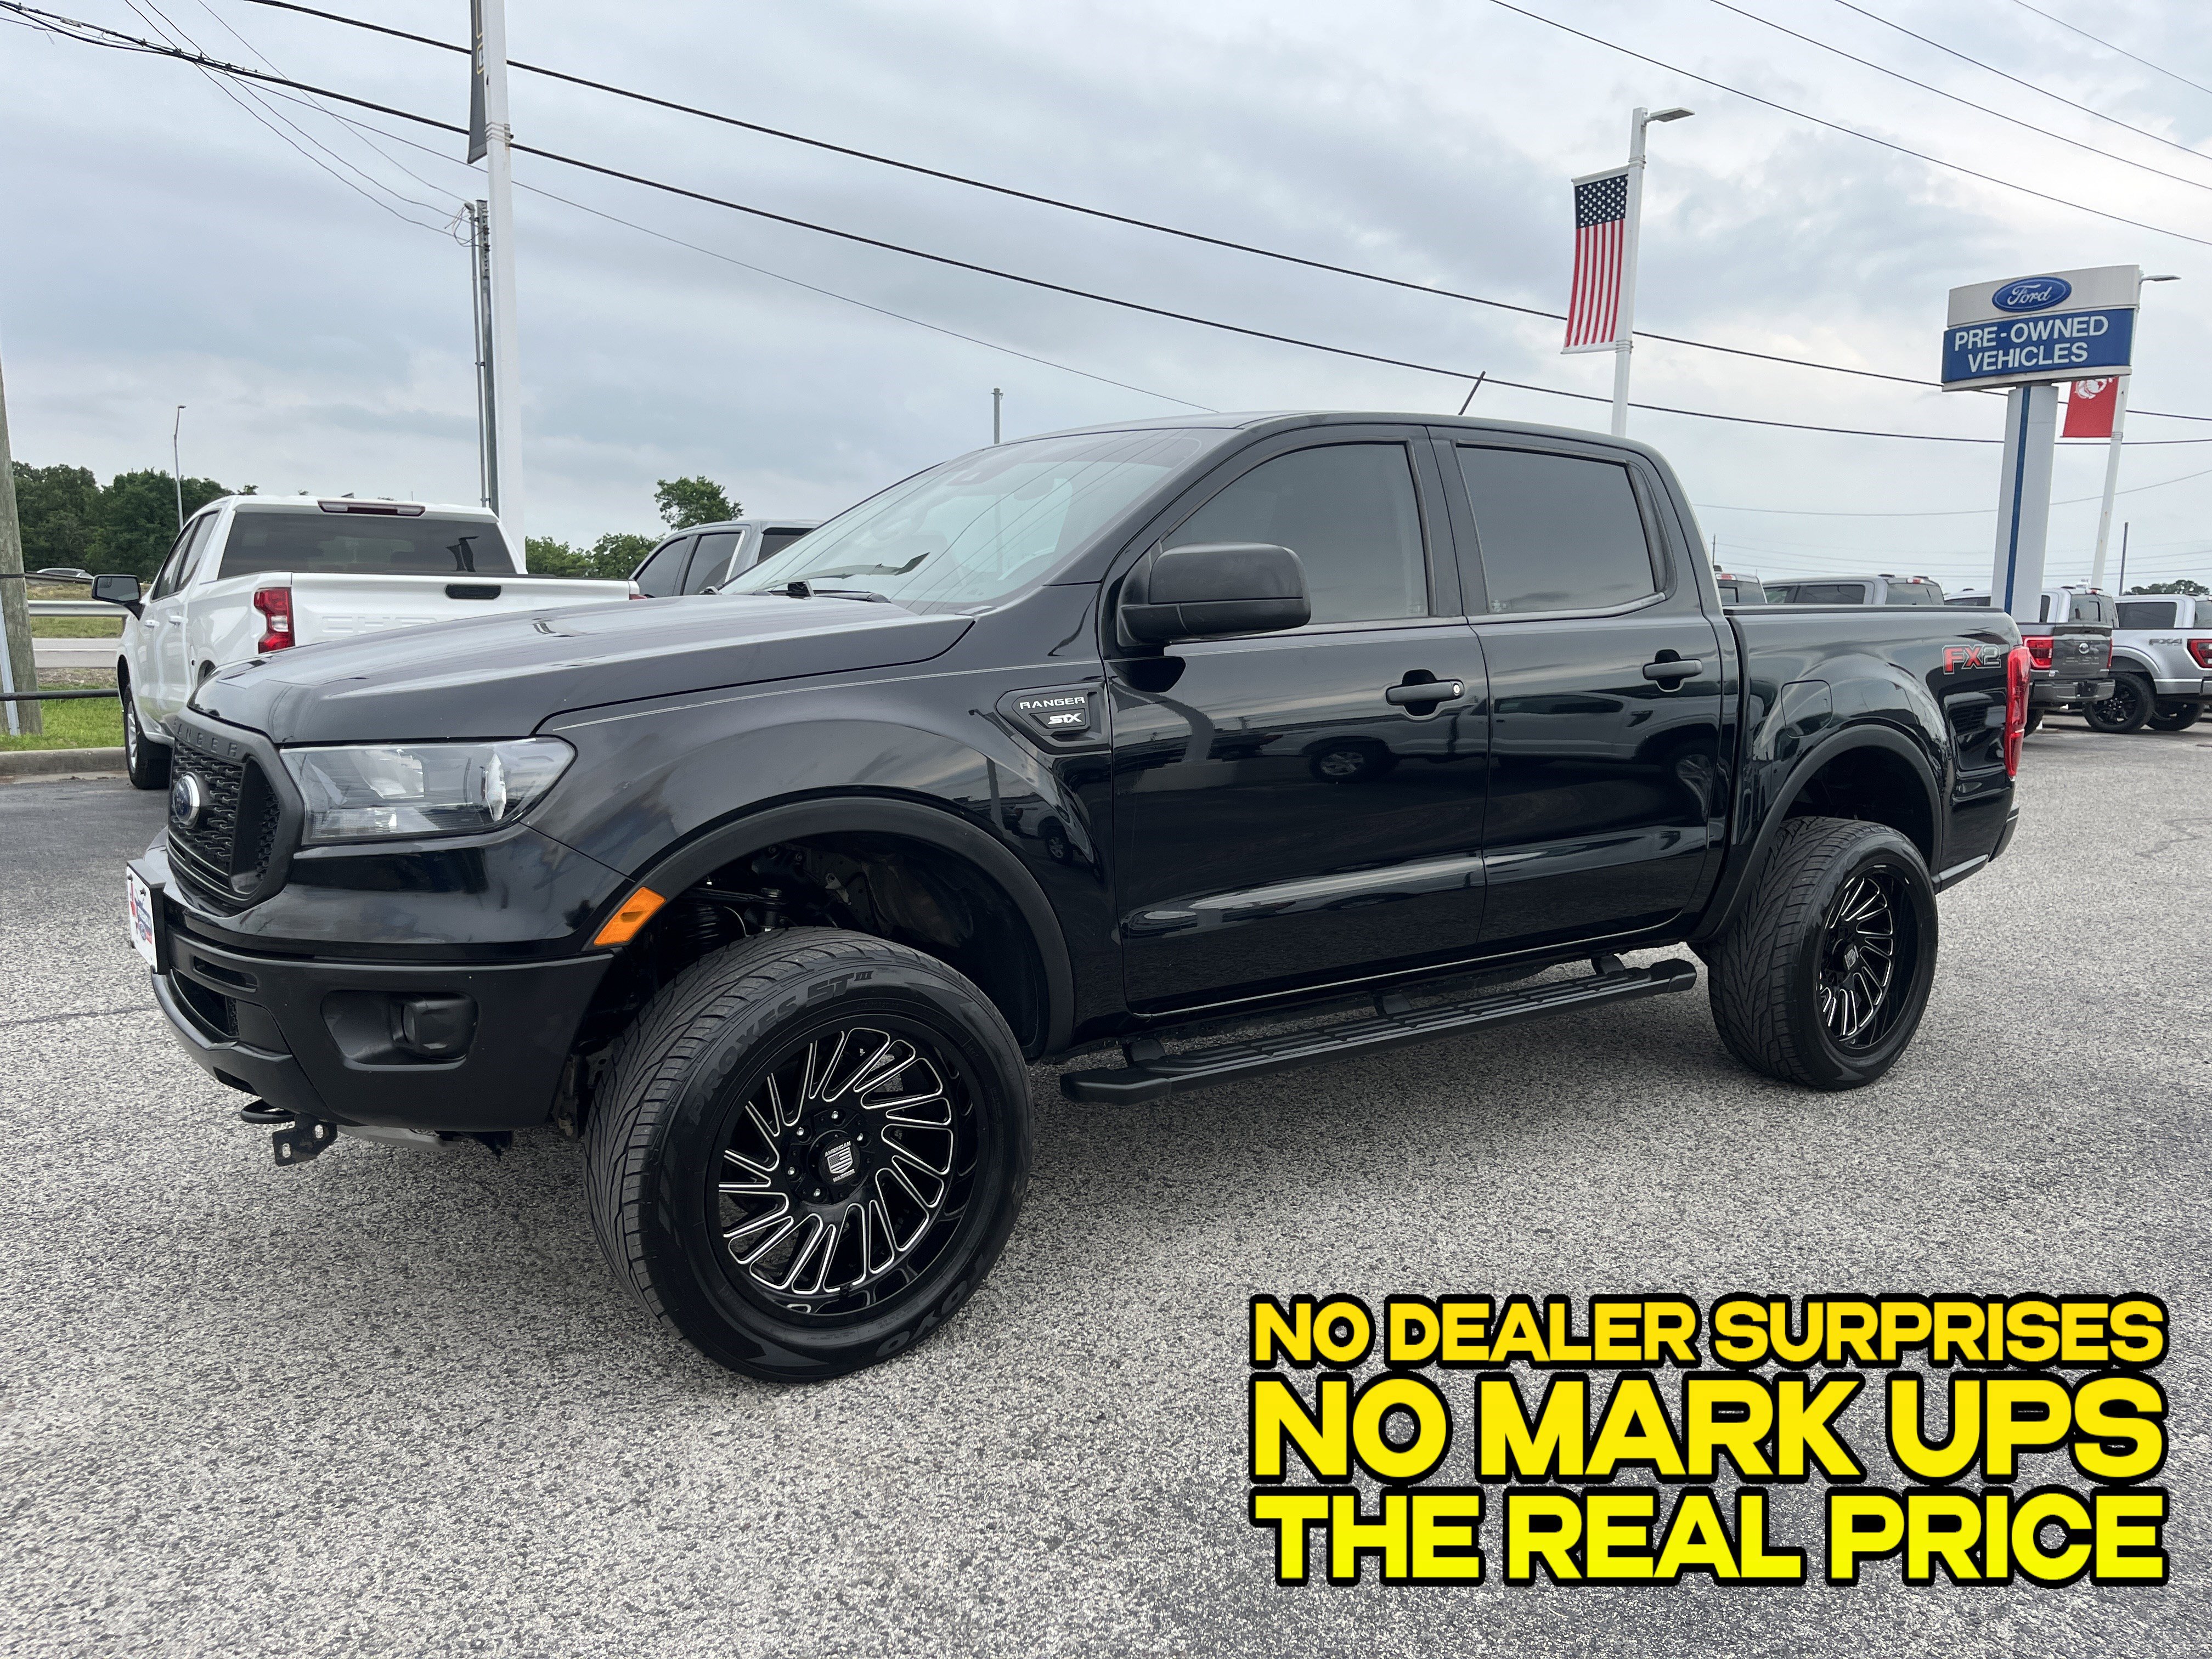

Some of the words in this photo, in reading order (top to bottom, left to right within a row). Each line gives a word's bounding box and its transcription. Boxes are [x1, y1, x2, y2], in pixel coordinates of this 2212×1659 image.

[2006, 283, 2053, 306] Ford
[1967, 341, 2089, 373] VEHICLES
[1942, 644, 2002, 675] FX2
[1019, 696, 1085, 710] RANGER
[1047, 713, 1083, 725] STX
